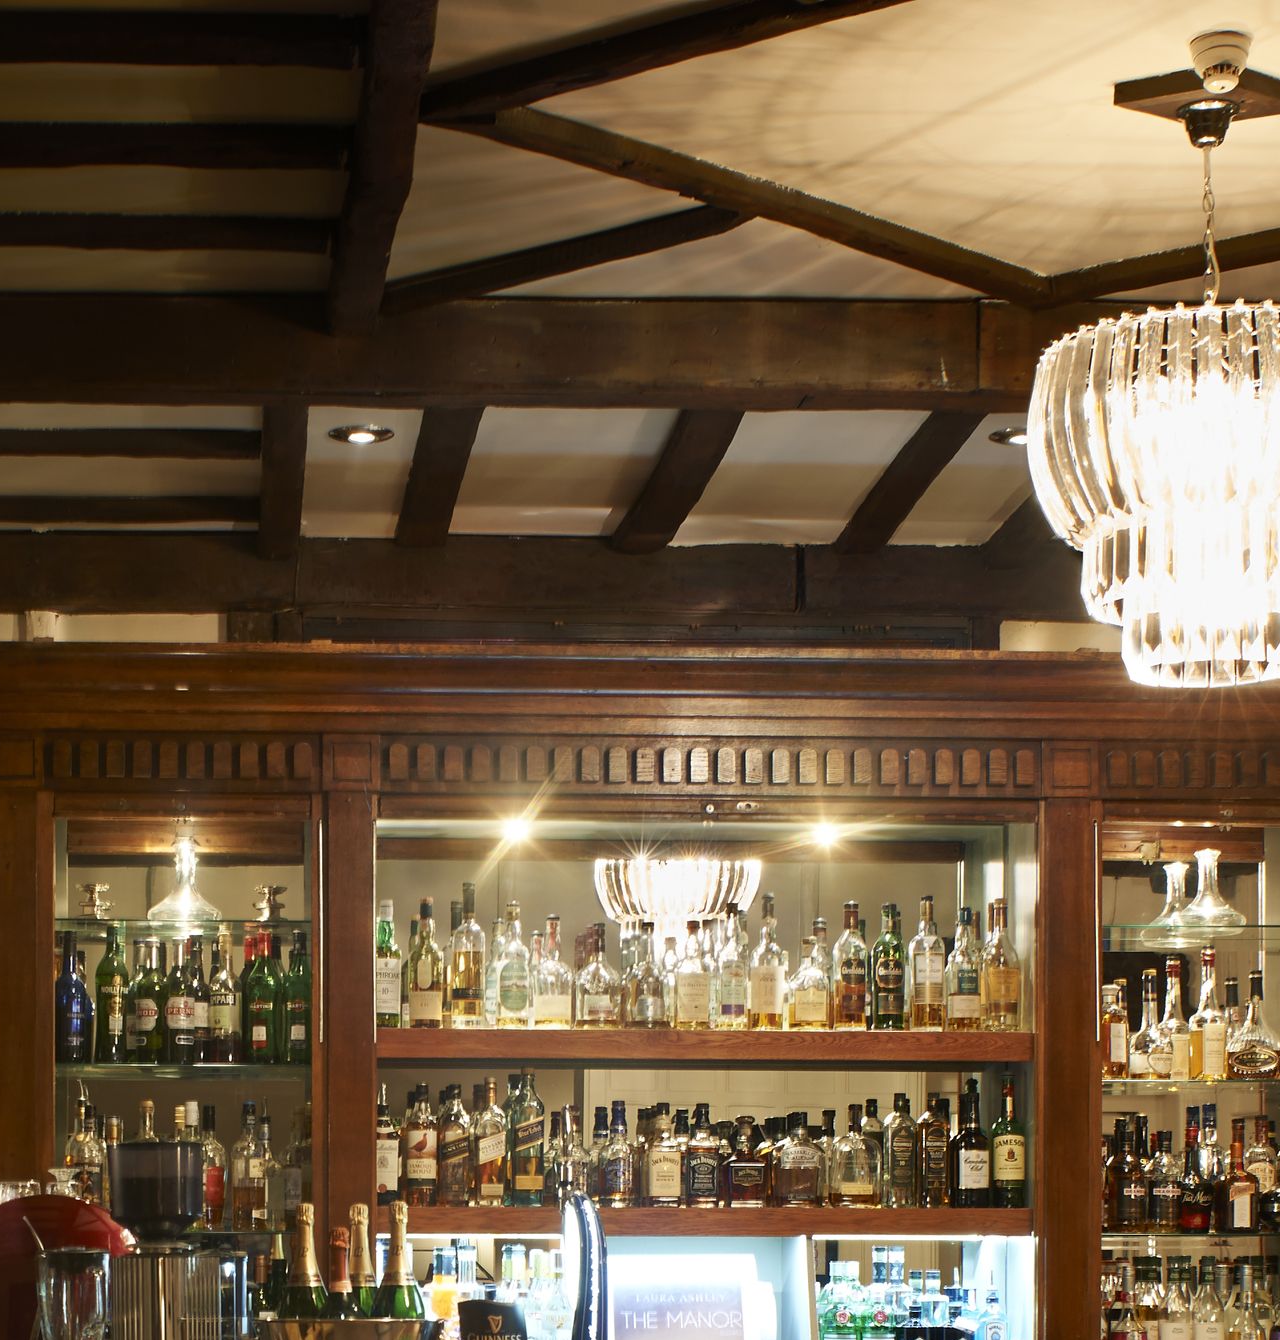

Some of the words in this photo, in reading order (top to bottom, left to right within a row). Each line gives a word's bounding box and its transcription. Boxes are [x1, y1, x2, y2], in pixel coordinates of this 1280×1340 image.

[635, 1292, 676, 1303] LAURA
[679, 1292, 726, 1303] ASHLEY
[620, 1310, 658, 1329] THE
[666, 1310, 743, 1329] MANOR
